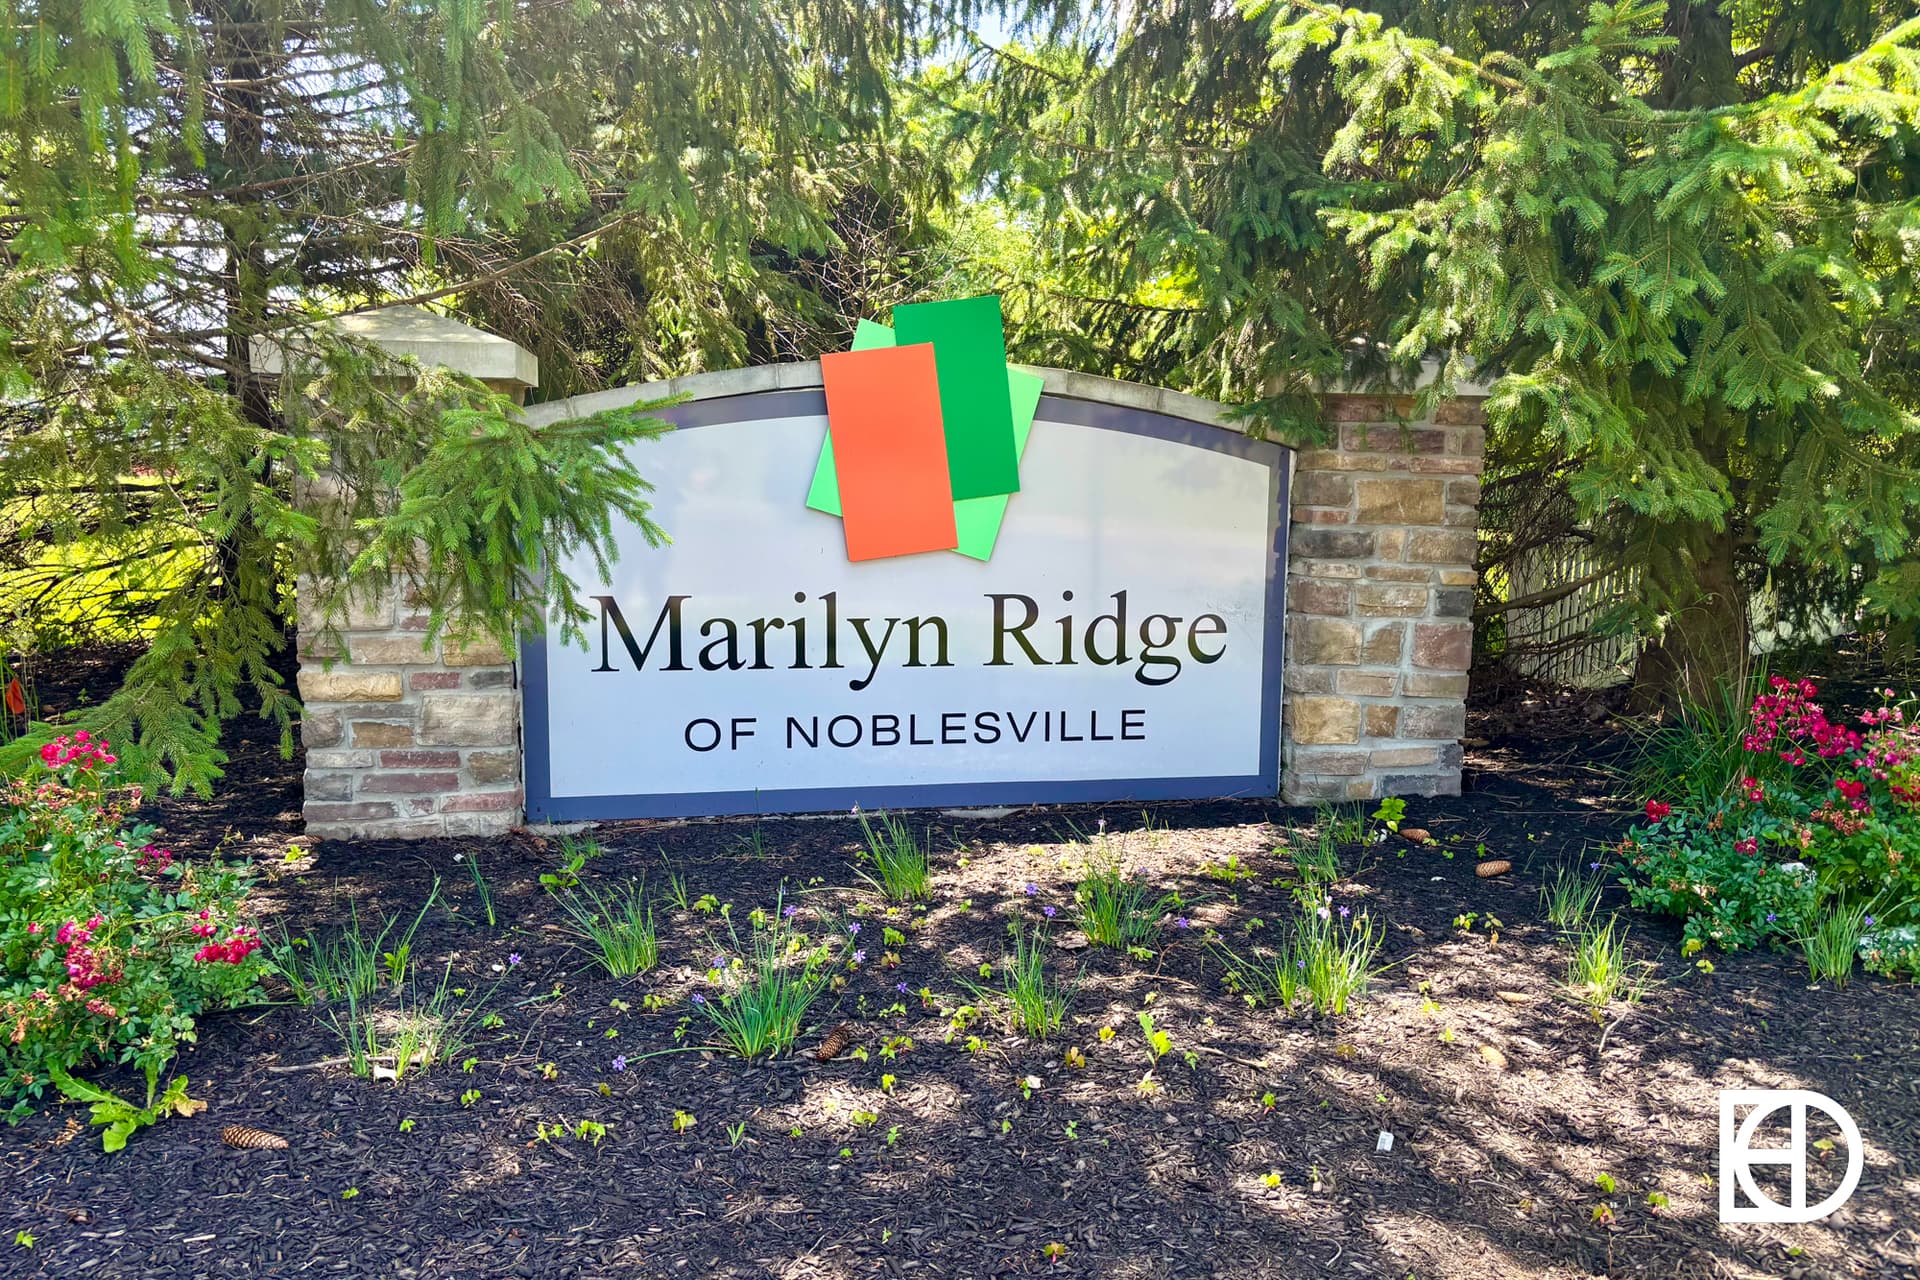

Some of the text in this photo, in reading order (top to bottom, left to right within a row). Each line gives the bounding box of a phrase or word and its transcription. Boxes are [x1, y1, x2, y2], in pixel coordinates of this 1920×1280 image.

[589, 590, 1227, 692] Marilyn Ridge
[684, 709, 1146, 752] OF NOBLESVILLE
